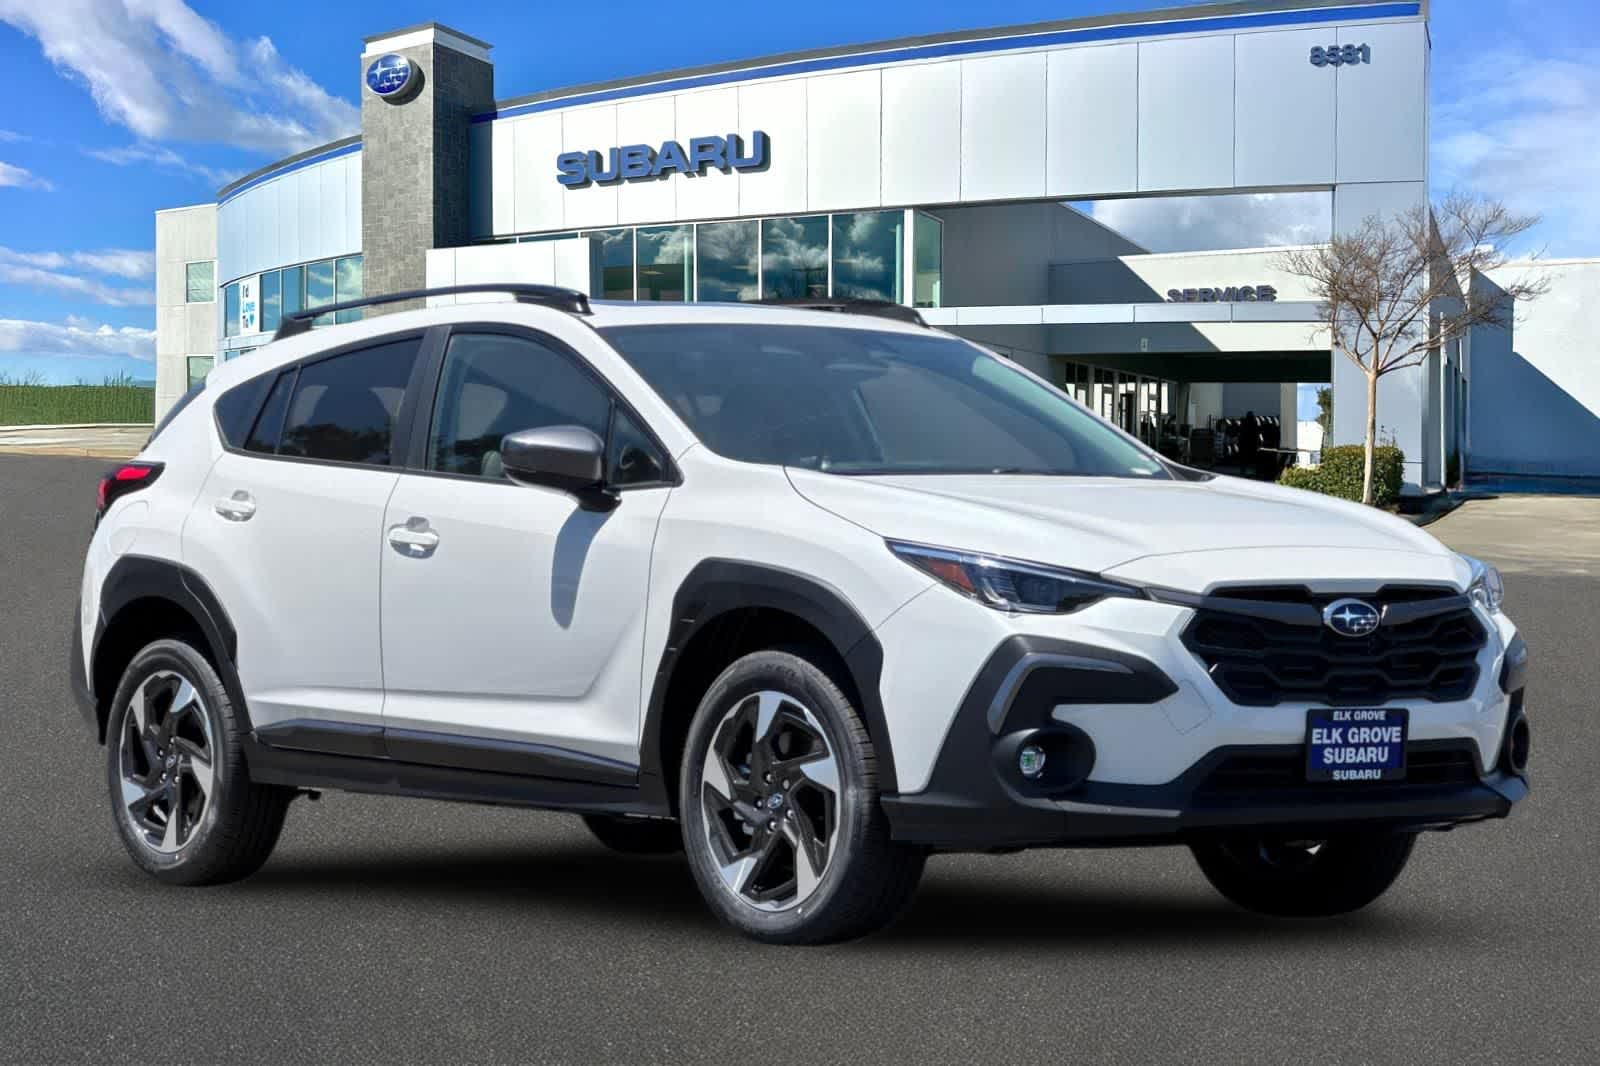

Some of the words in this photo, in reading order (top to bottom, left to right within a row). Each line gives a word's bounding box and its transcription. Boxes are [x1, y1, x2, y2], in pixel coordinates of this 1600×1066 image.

[556, 130, 770, 190] SUBARU
[1167, 285, 1277, 302] SERVICE
[1333, 710, 1352, 720] ELK
[1354, 710, 1387, 720] GROVE
[1312, 728, 1343, 744] ELK
[1348, 727, 1402, 743] GROVE
[1323, 746, 1389, 764] SUBARU
[1333, 769, 1381, 780] SUBARU
